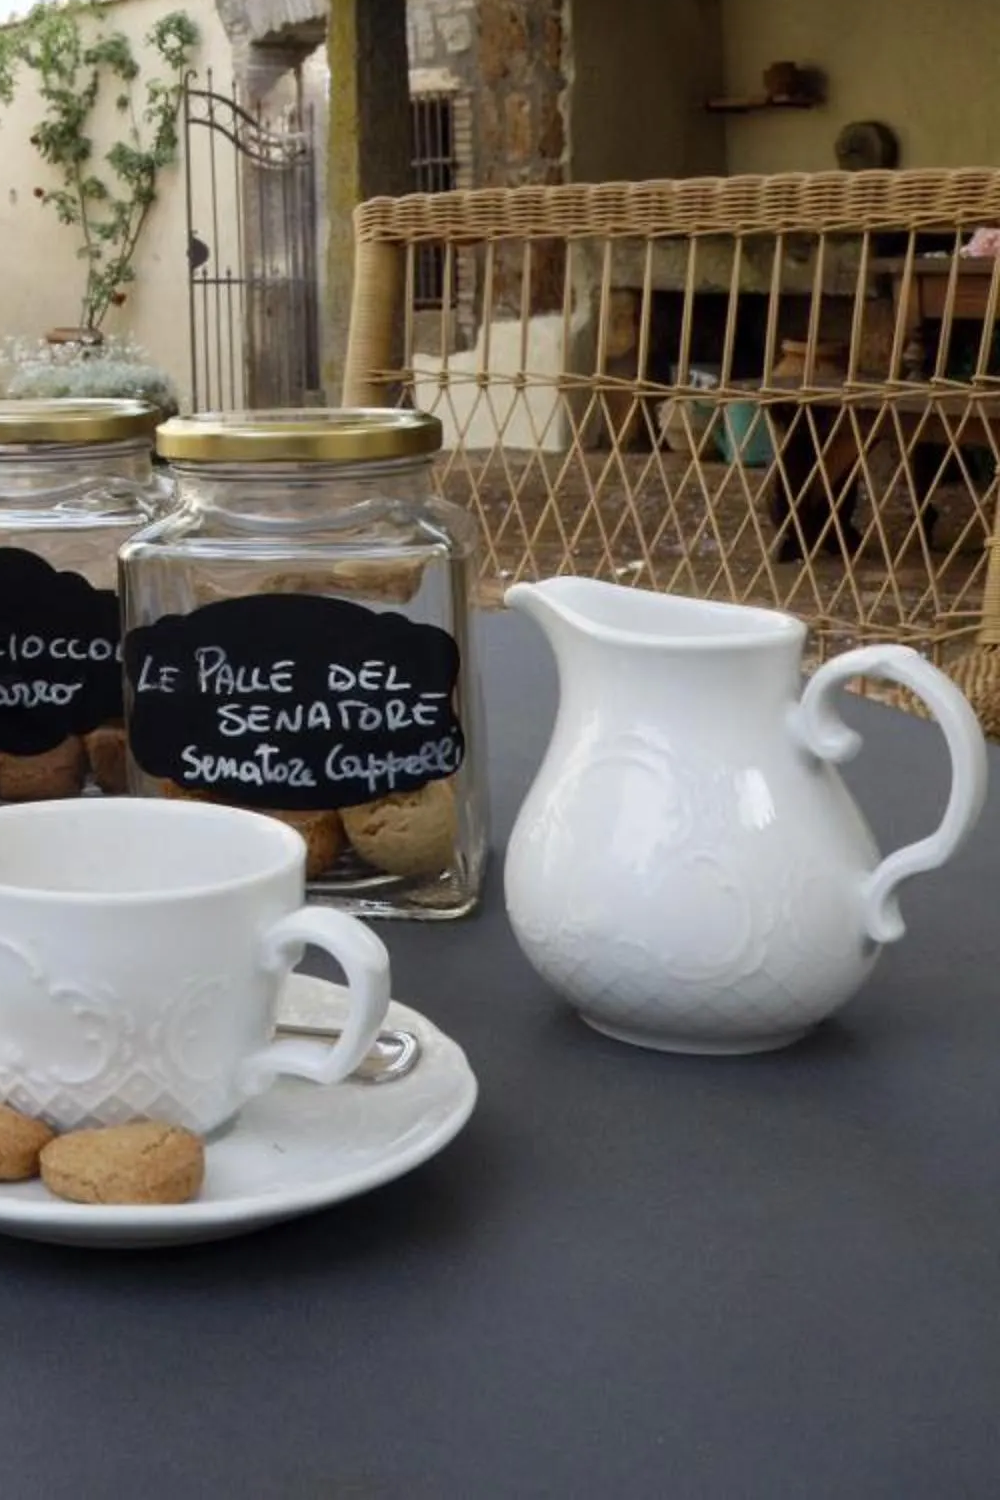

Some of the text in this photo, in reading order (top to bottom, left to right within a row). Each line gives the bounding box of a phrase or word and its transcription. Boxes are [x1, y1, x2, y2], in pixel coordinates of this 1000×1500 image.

[137, 645, 412, 696] LE PALLE DEL
[217, 693, 448, 737] SENATORE
